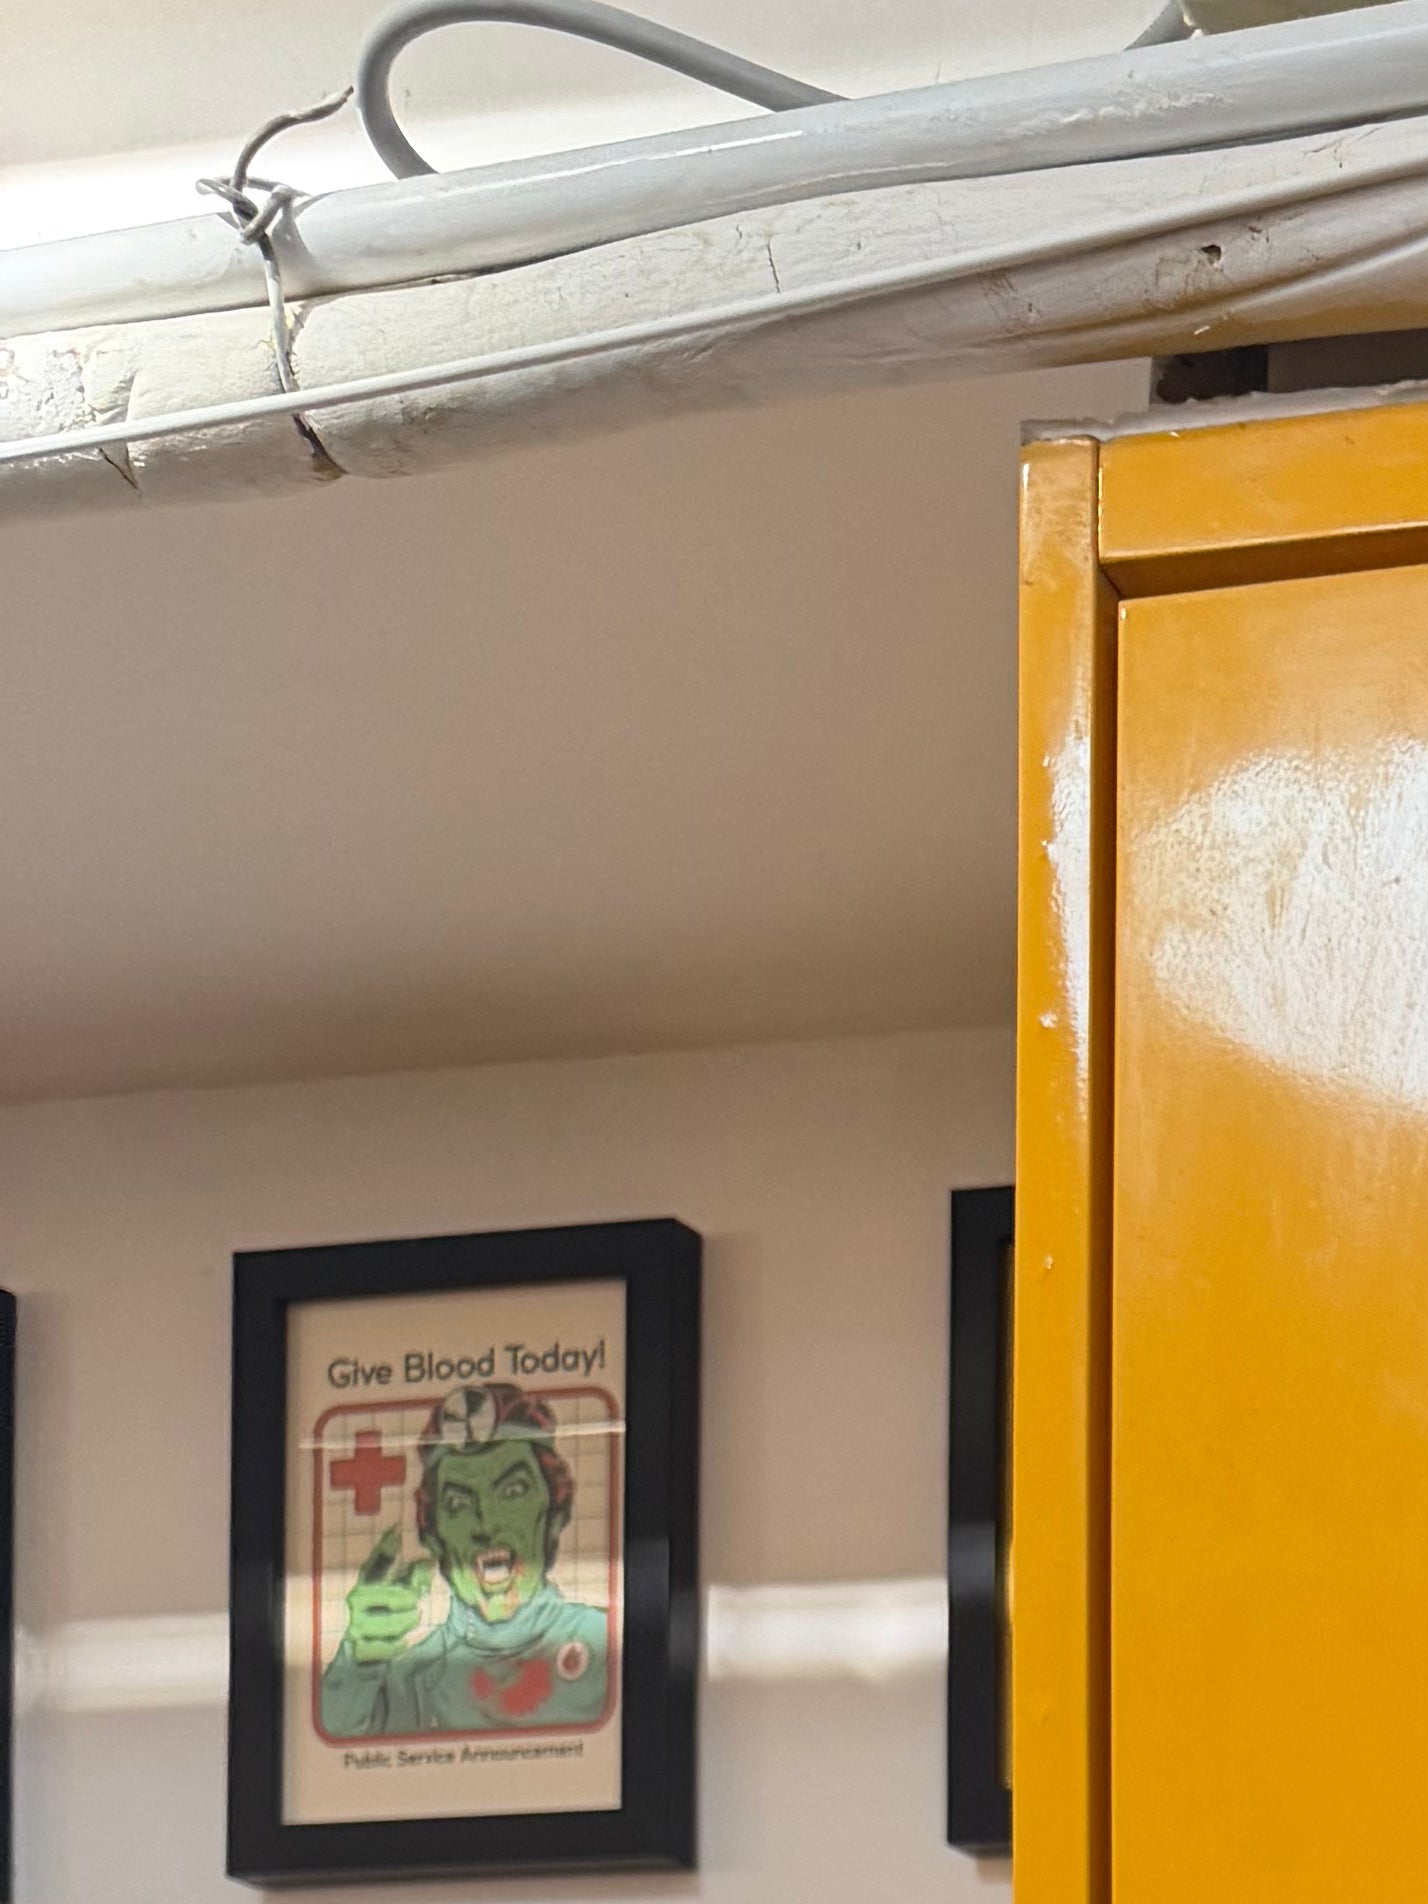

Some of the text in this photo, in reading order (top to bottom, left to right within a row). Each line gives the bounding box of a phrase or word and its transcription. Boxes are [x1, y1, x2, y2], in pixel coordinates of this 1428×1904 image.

[327, 1339, 607, 1389] Give Blood Today!
[343, 1740, 585, 1770] Public Service Announcement
